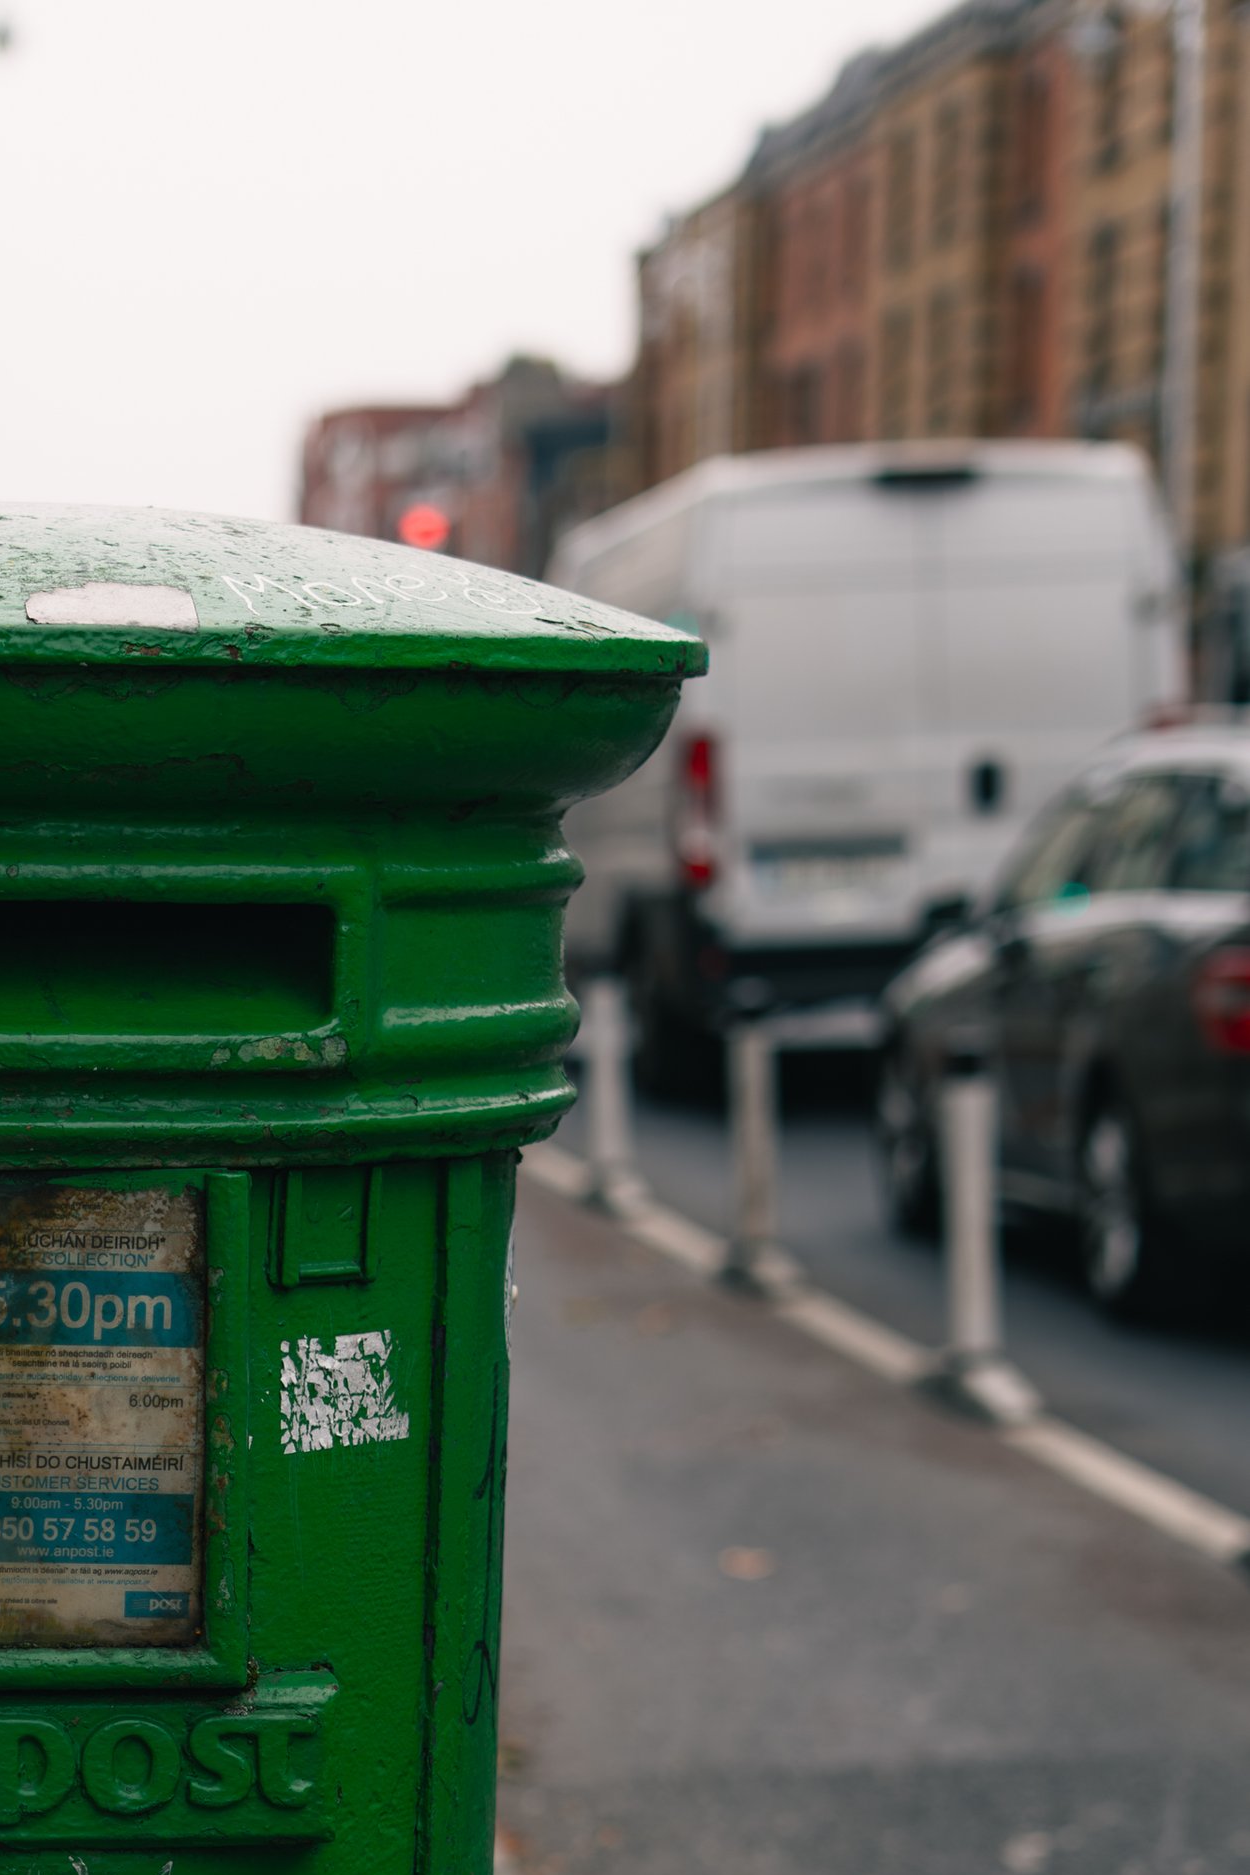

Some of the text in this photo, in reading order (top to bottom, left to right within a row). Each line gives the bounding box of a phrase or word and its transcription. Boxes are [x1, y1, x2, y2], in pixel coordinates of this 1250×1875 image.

[128, 1393, 184, 1410] 6.00pm
[36, 1455, 60, 1469] DO
[65, 1454, 184, 1471] CHUSTAIMÉIRÍ
[76, 1476, 160, 1491] SERVICES
[74, 1497, 124, 1512] 5.30pm
[43, 1518, 76, 1540] 57
[83, 1519, 116, 1541] 58
[124, 1520, 157, 1543] 59
[17, 1545, 115, 1560] www.anpost.ie
